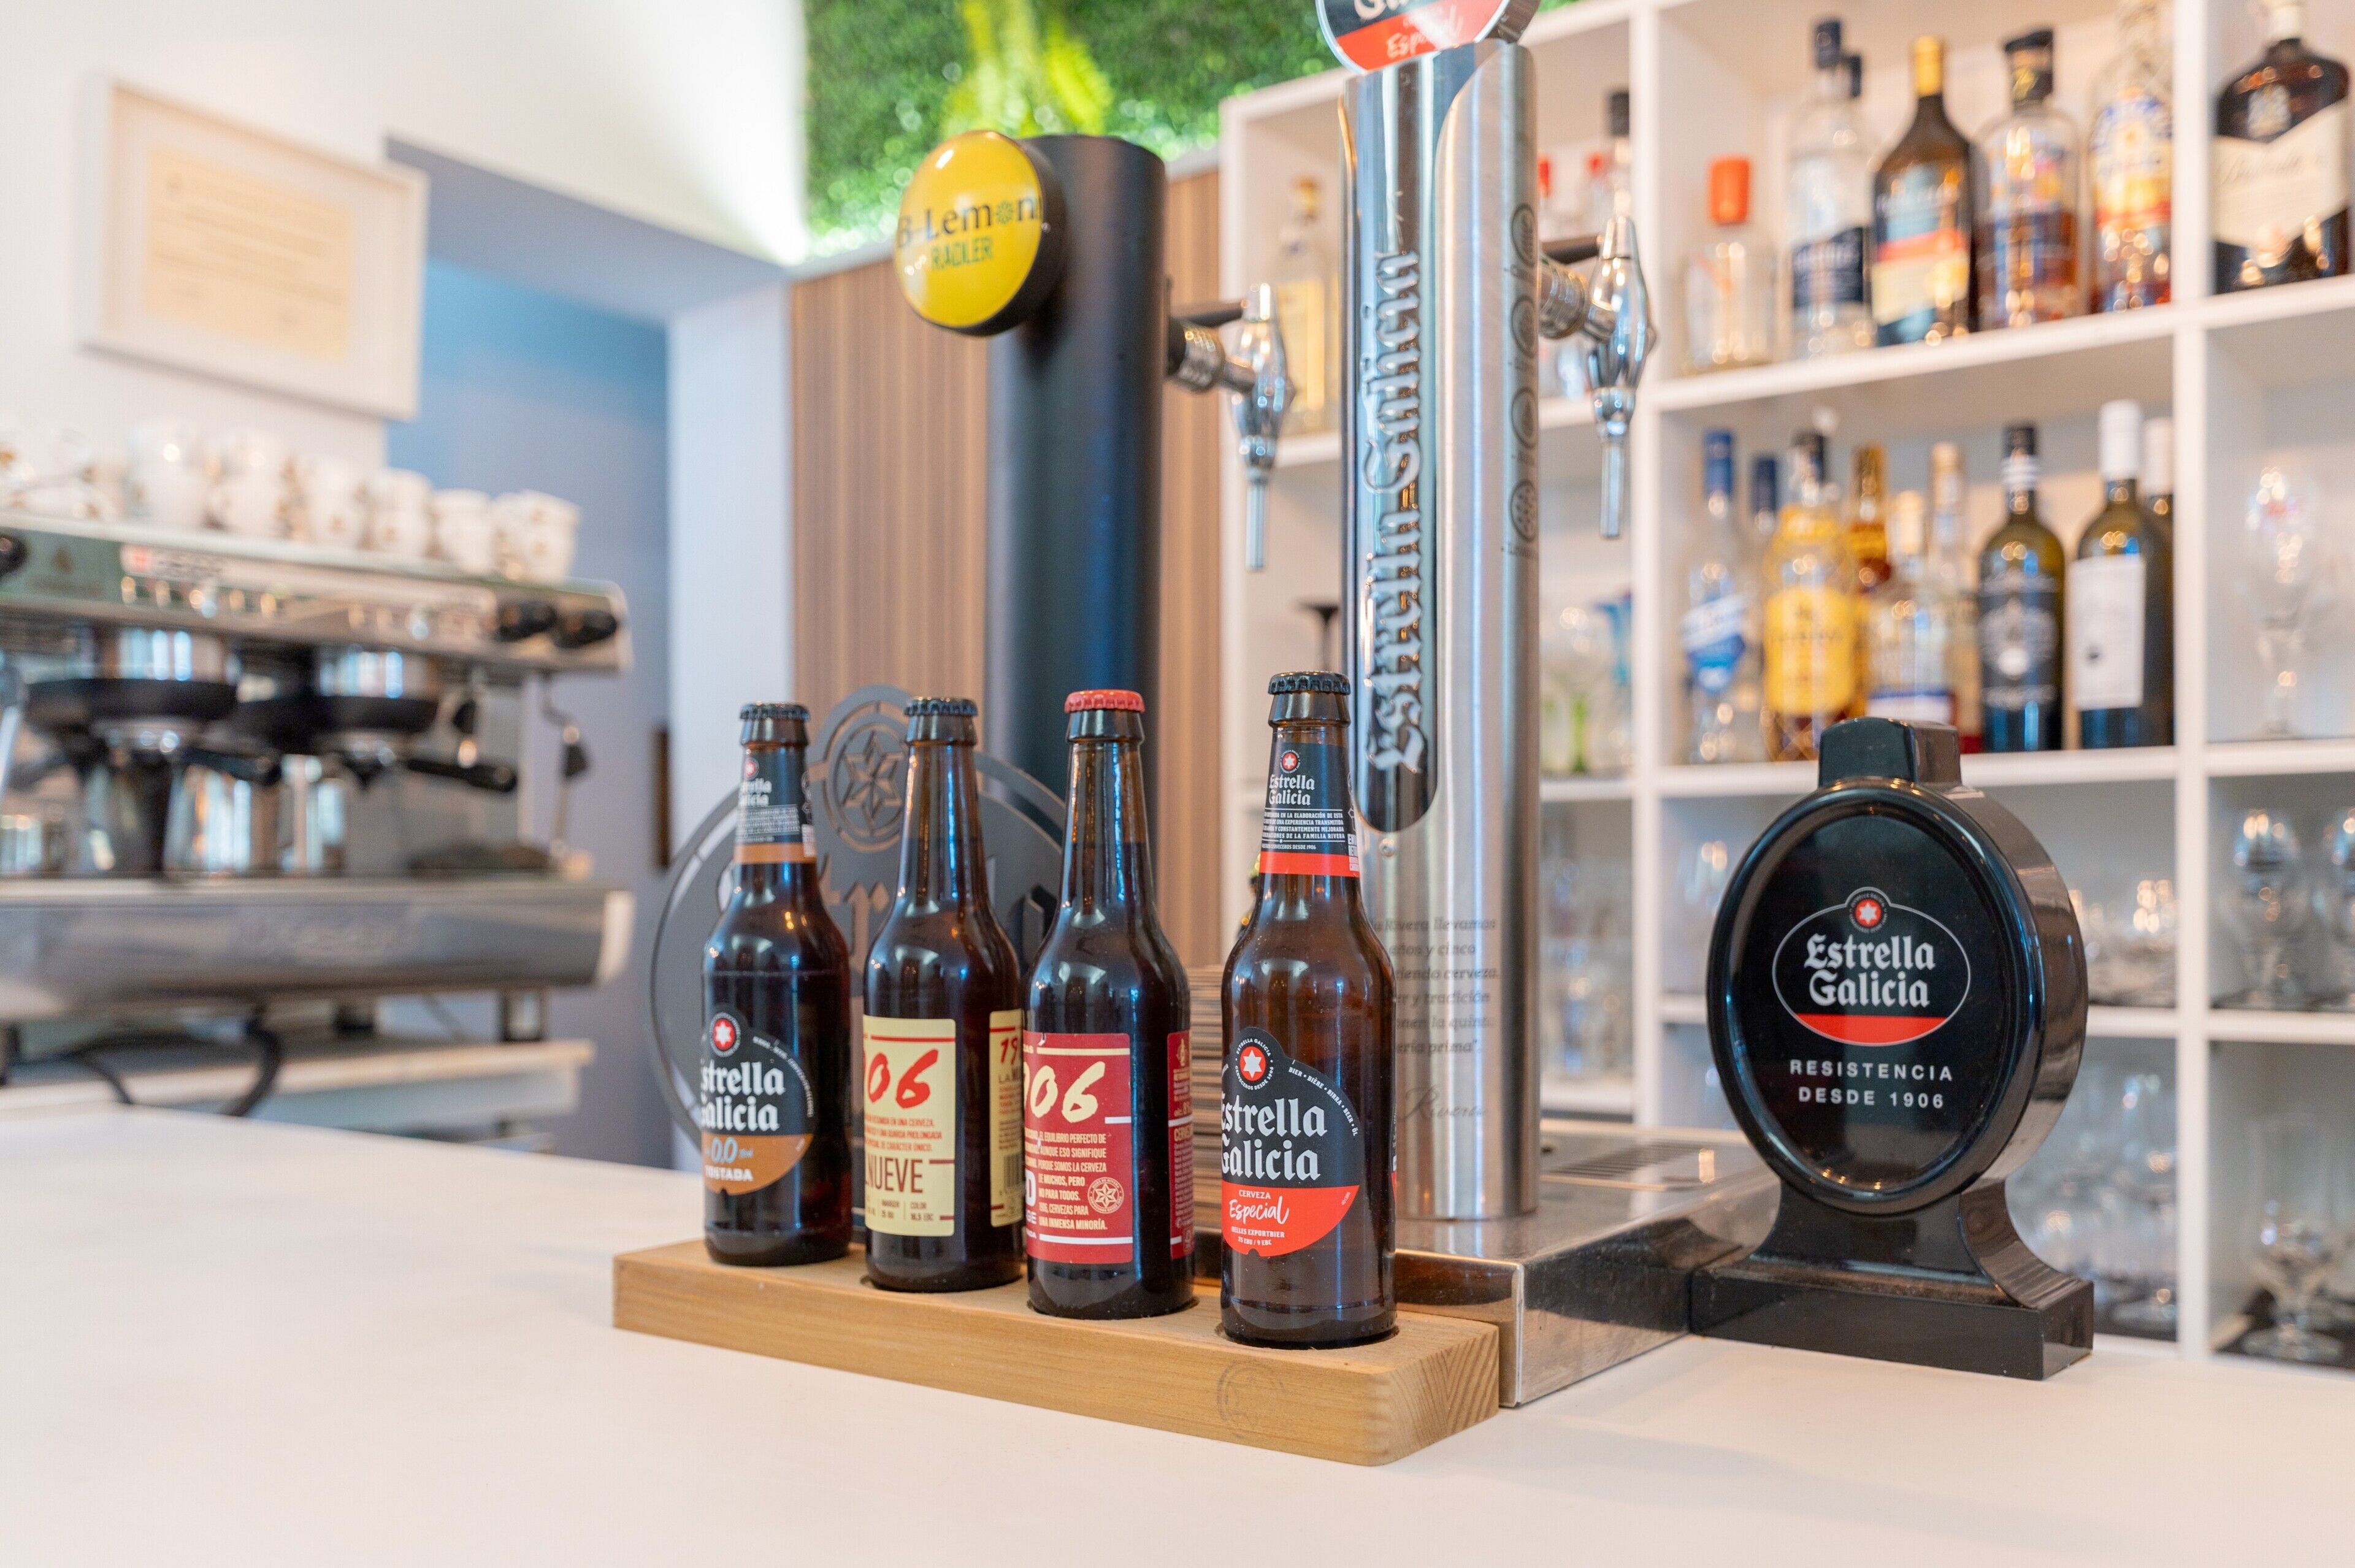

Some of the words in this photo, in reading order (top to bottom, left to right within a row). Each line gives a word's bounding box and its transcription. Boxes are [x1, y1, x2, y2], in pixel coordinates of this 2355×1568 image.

[1363, 250, 1421, 493] Galicia
[1365, 508, 1427, 774] Estrella
[1269, 774, 1315, 790] Estrella
[1269, 790, 1311, 806] Galicia
[1804, 933, 1936, 970] Estrella
[1809, 969, 1930, 1008] Galicia
[1254, 1038, 1271, 1057] GALICIA
[701, 1058, 786, 1096] strella
[864, 1049, 938, 1109] 06
[1790, 1060, 1953, 1082] RESISTENCIA
[1254, 1079, 1268, 1090] DESDE
[1288, 1067, 1303, 1077] BIER
[1307, 1077, 1325, 1089] BIÈRE
[1327, 1089, 1342, 1106] BIRRA
[1342, 1107, 1354, 1123] BEER
[1799, 1087, 1875, 1106] DESDE
[1890, 1092, 1943, 1109] 1906
[701, 1095, 780, 1131] alicia
[1044, 1132, 1069, 1143] EQUILIBRIO
[1070, 1133, 1097, 1144] PERFECTO
[1098, 1133, 1106, 1144] DE
[1059, 1147, 1071, 1158] ESO
[1071, 1147, 1107, 1158] SIGNIFIQUE
[865, 1155, 923, 1193] NUEVE
[1073, 1161, 1080, 1172] LA
[1080, 1162, 1107, 1172] CERVEZA
[1068, 1176, 1086, 1187] PERO
[1045, 1188, 1059, 1200] PARA
[1059, 1190, 1081, 1201] TODOS.
[1238, 1189, 1271, 1199] CERVEZA
[1049, 1203, 1074, 1215] CERVEZAS
[1073, 1205, 1089, 1216] PARA
[1229, 1195, 1290, 1225] Especial
[1048, 1217, 1075, 1230] INMENSA
[1075, 1218, 1108, 1230] MINORÍA.
[1247, 1228, 1285, 1238] EXPORTBIER
